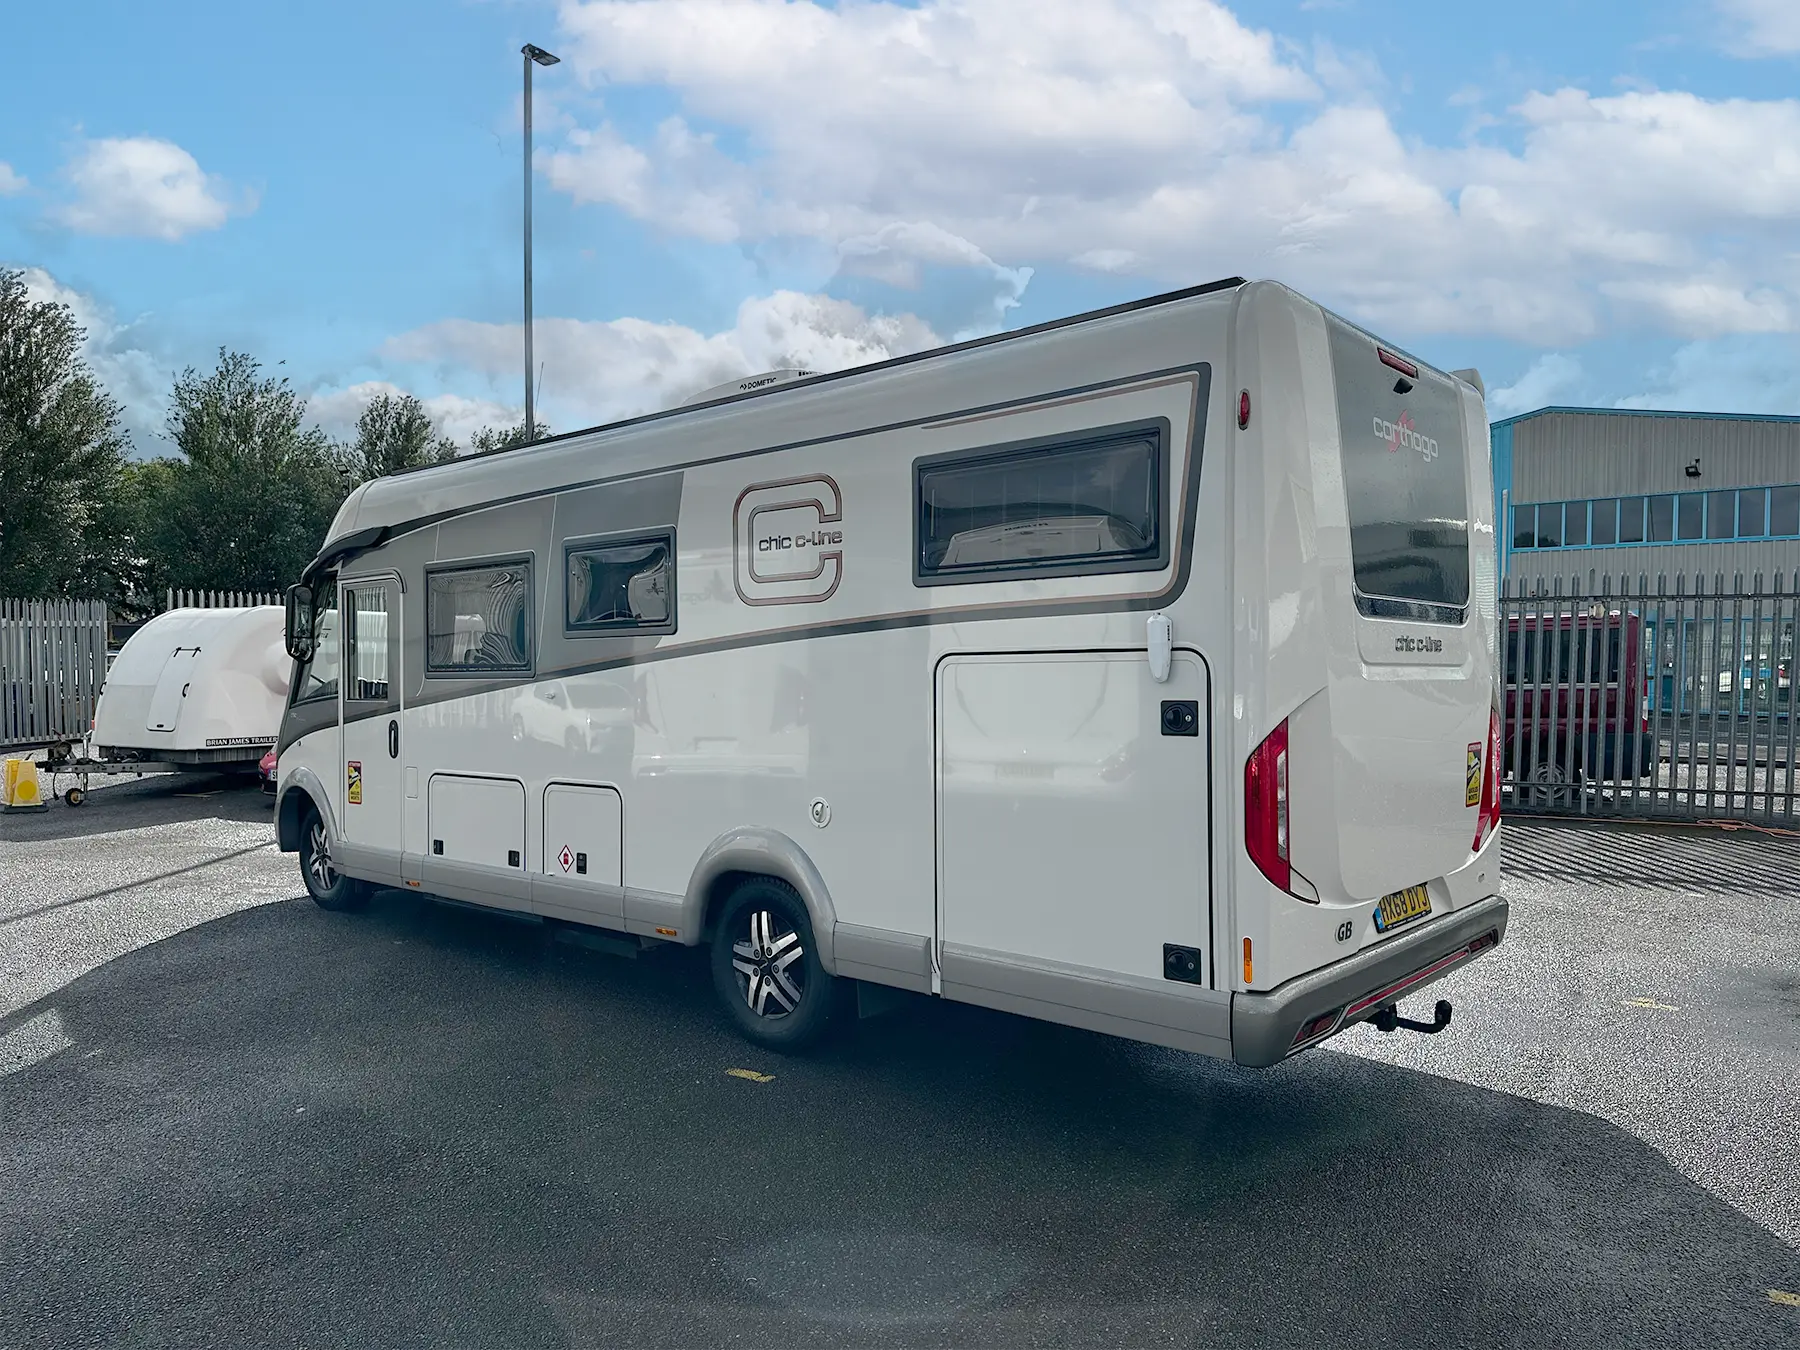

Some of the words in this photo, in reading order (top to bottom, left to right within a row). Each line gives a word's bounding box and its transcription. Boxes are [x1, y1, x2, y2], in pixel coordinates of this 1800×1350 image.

[747, 377, 777, 390] DOMETIC
[1373, 416, 1439, 463] carthago
[758, 535, 792, 552] chic
[795, 530, 843, 548] c-line
[206, 739, 228, 747] BRIAN
[228, 737, 250, 746] JAMES
[1379, 888, 1409, 923] HX68
[1407, 884, 1429, 913] DYJ
[1337, 920, 1353, 942] GB
